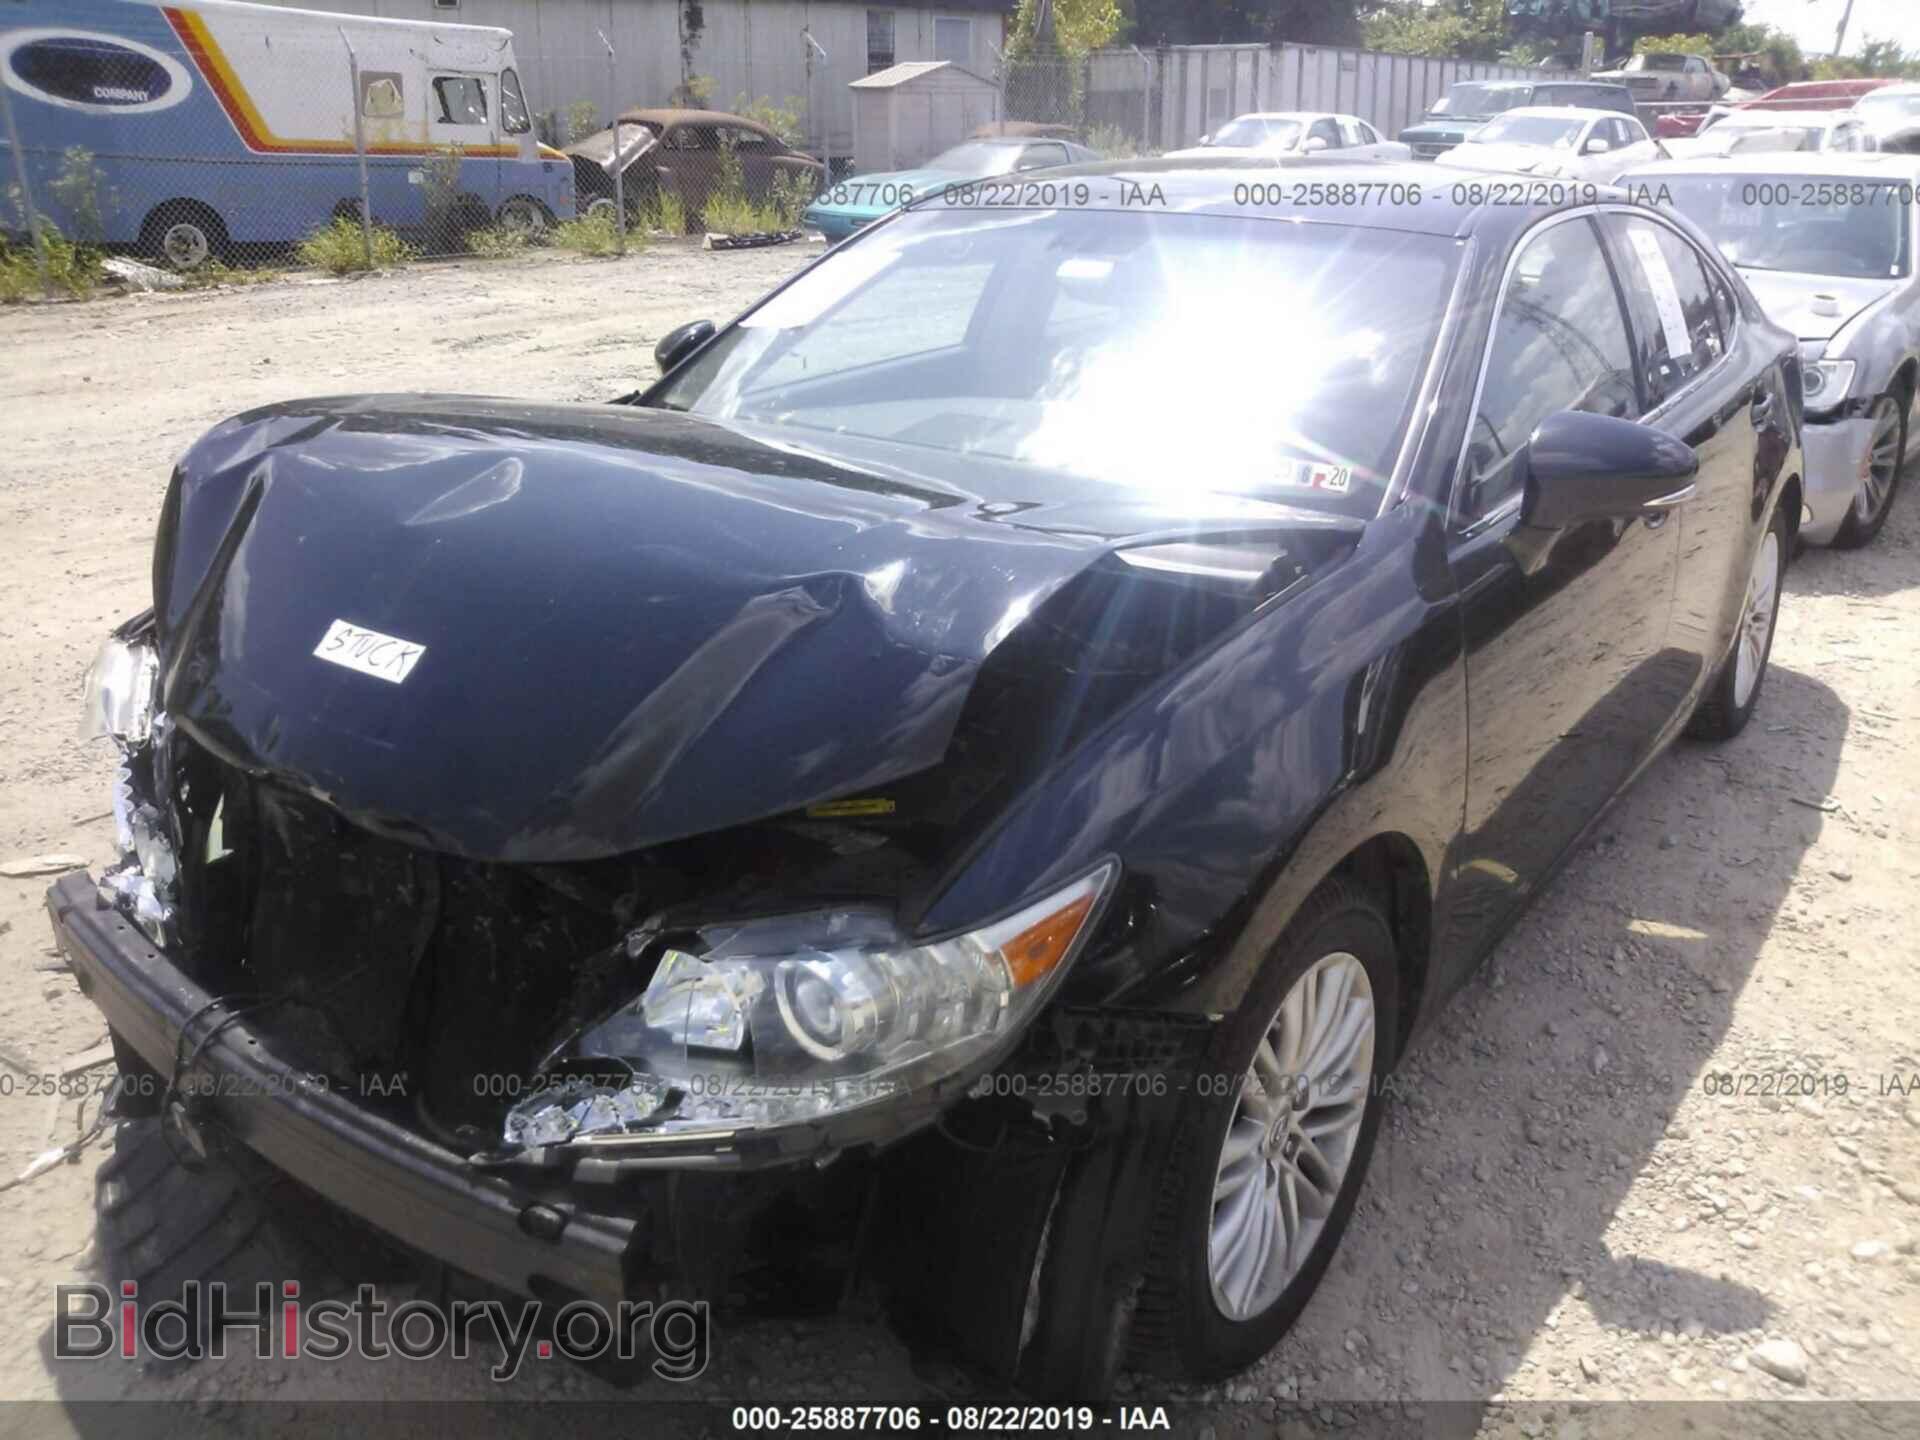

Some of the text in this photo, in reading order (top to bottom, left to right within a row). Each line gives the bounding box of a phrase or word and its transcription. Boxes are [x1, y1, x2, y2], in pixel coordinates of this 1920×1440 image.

[94, 86, 149, 102] COMPANY
[1329, 466, 1348, 487] 20
[326, 628, 420, 677] STUCK
